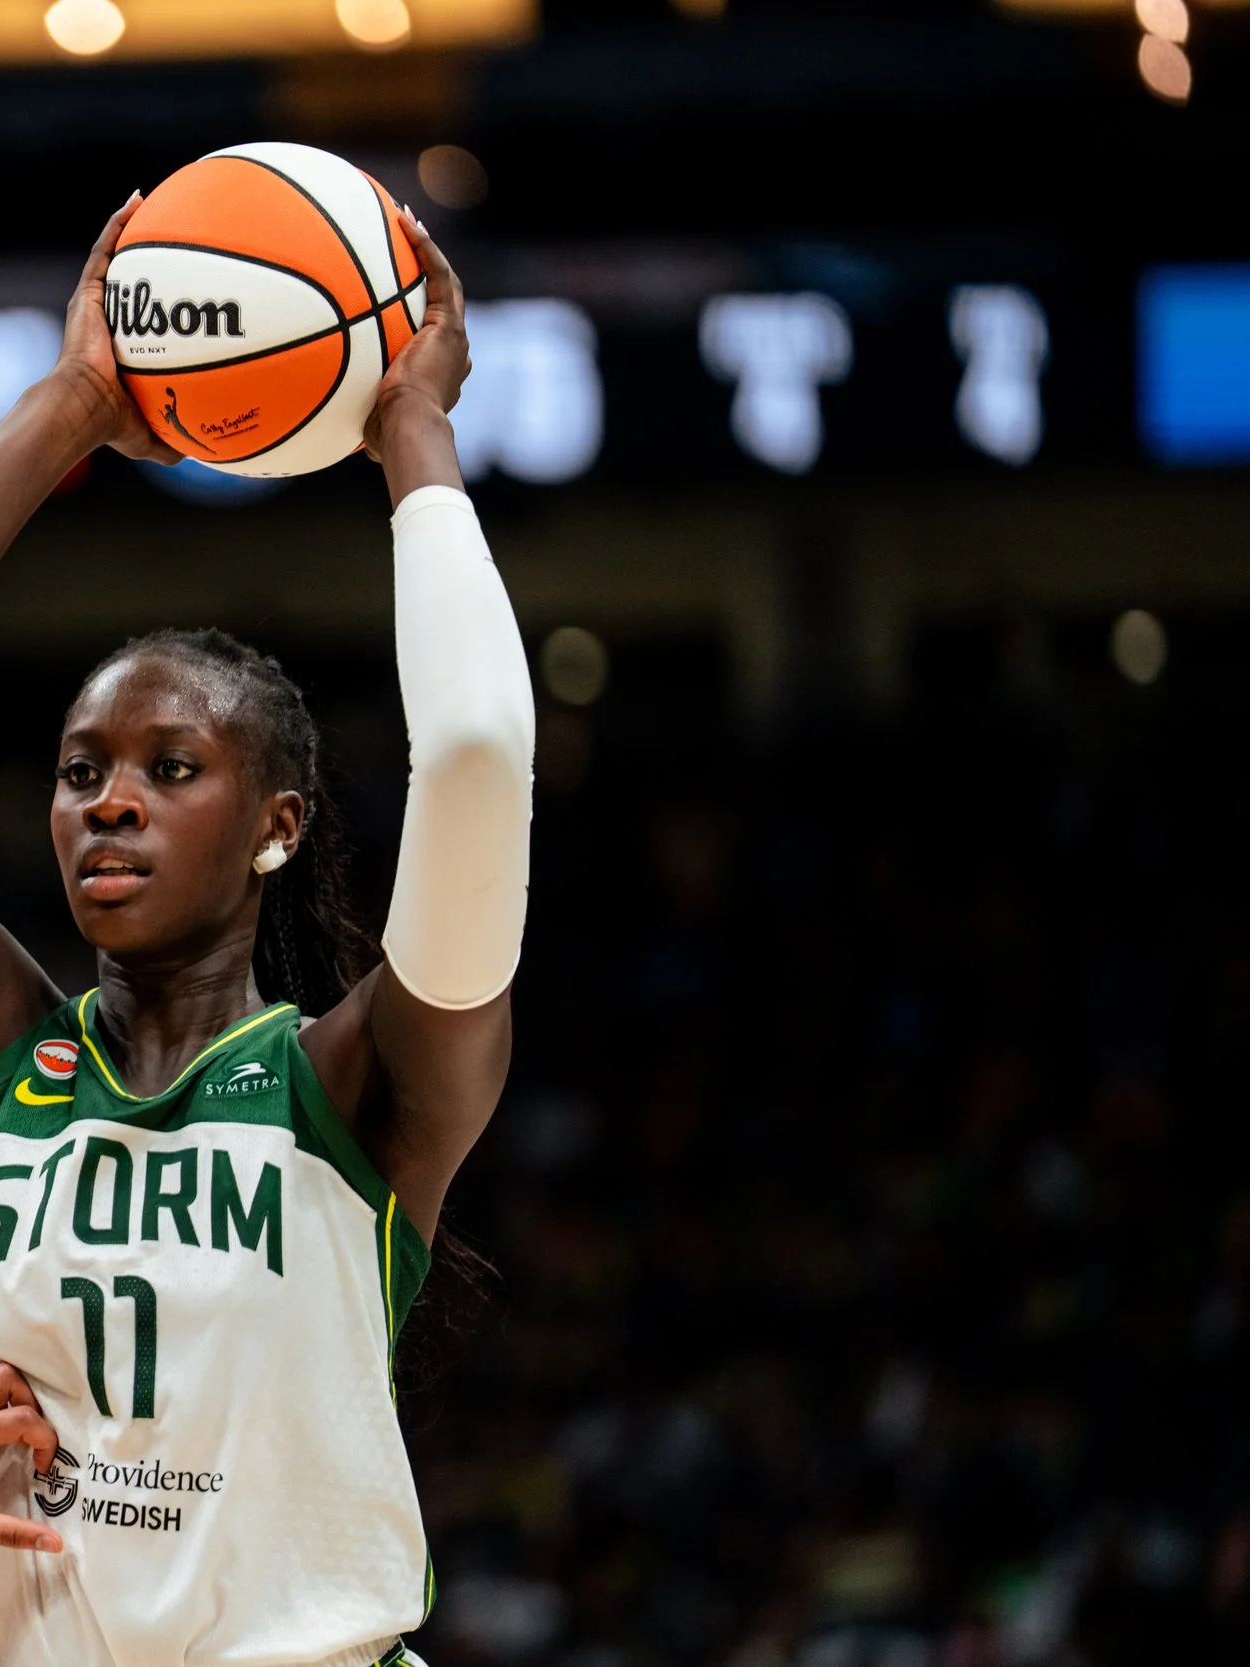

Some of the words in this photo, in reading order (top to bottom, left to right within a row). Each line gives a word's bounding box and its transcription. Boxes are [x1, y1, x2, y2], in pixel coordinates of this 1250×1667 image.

[205, 1076, 280, 1095] SYMETRA
[61, 1274, 158, 1420] 11
[81, 1497, 182, 1531] SWEDISH
